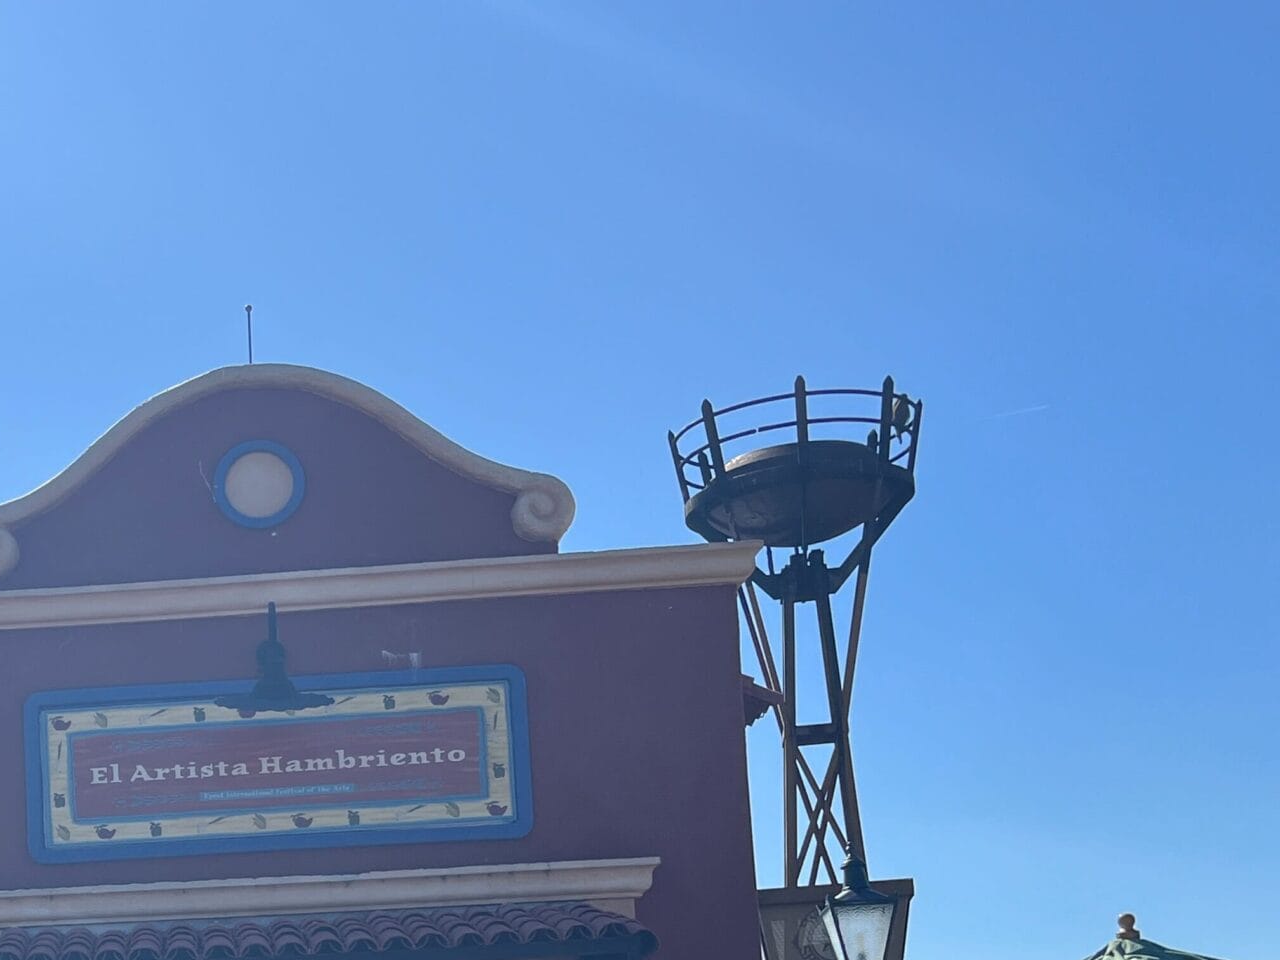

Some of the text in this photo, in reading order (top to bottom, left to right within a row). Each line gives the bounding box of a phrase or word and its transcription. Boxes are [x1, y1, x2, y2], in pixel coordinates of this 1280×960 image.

[89, 745, 466, 785] El Artista Hambriento
